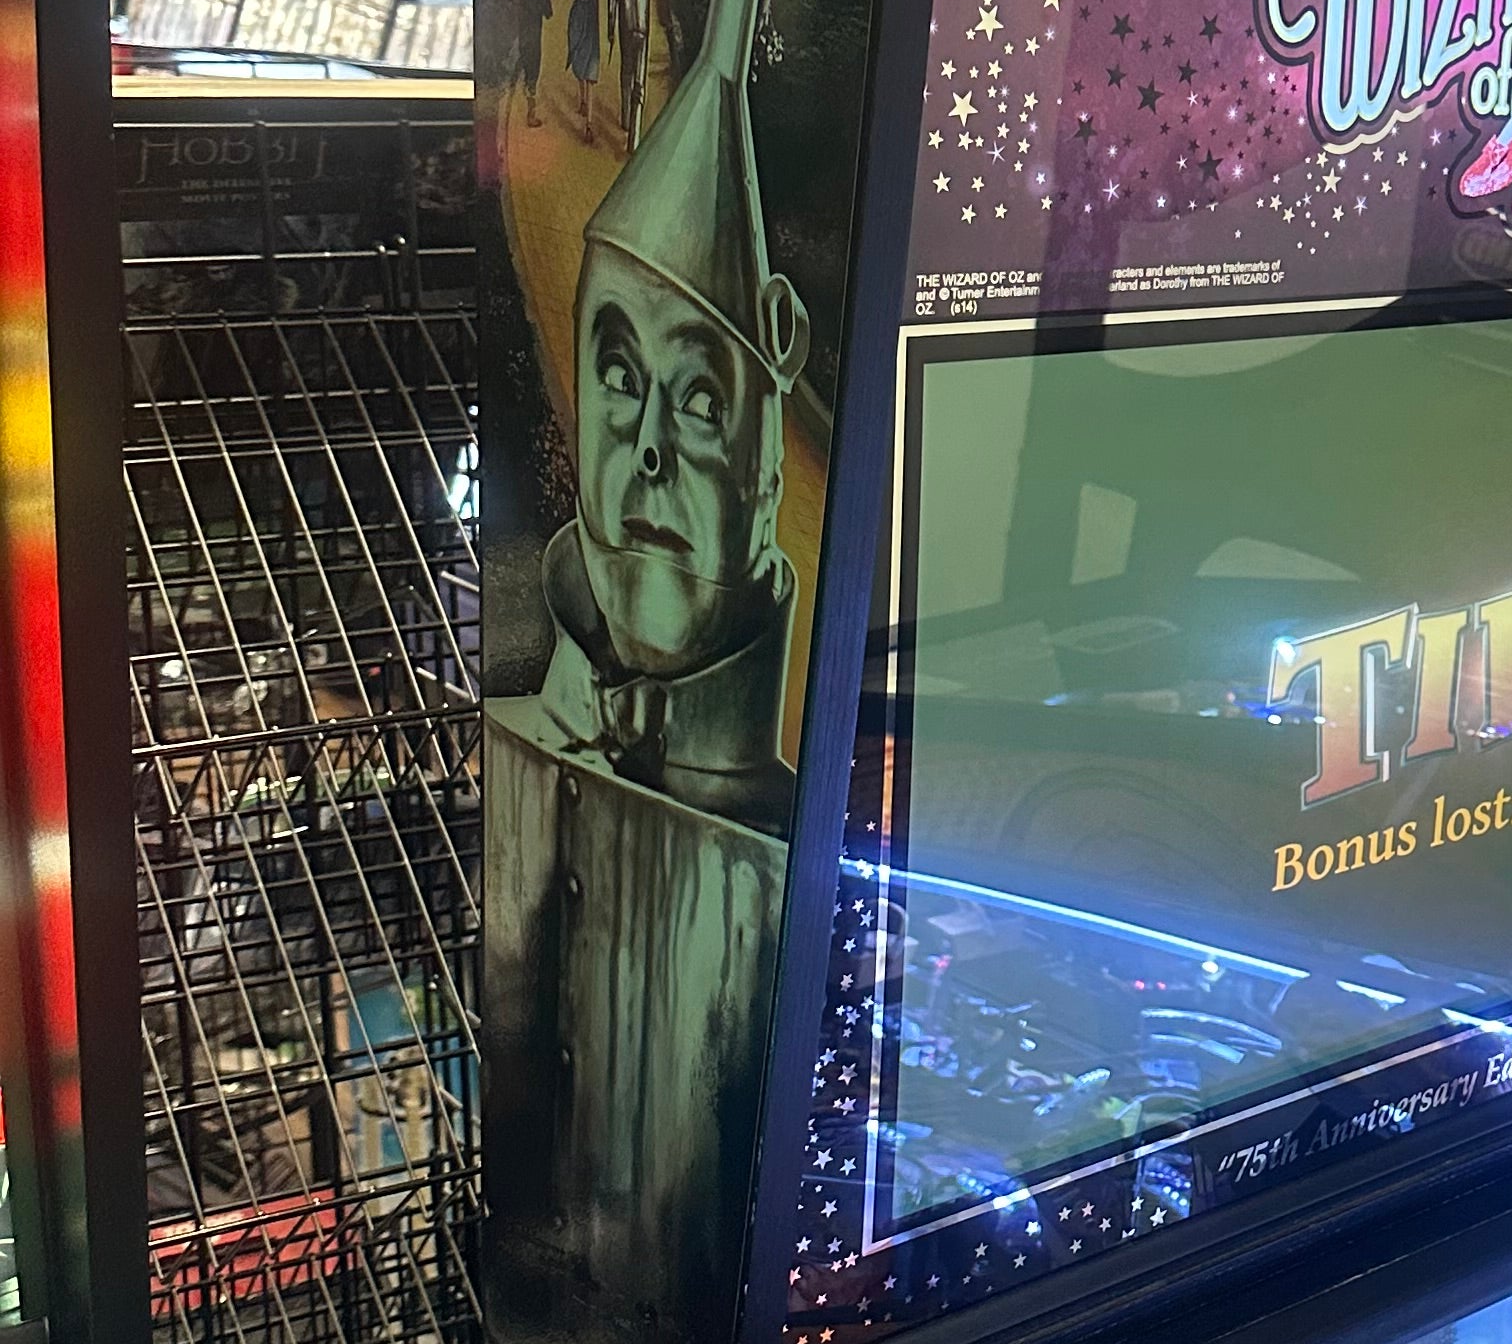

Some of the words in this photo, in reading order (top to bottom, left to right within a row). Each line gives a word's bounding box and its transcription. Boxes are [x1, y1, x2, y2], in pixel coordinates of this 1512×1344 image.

[916, 275, 941, 287] THE
[942, 272, 988, 286] WIZARD
[990, 271, 1007, 284] OF
[1008, 270, 1026, 283] OZ
[1112, 267, 1144, 279] racters
[1146, 264, 1163, 277] and
[1165, 263, 1205, 277] elements
[1206, 262, 1221, 274] are
[1223, 260, 1270, 273] trademarks
[1271, 259, 1281, 271] of
[1139, 279, 1151, 291] as
[1153, 277, 1189, 291] Dorothy
[1190, 276, 1210, 288] from
[1211, 275, 1231, 287] THE
[1232, 272, 1270, 285] WIZARD
[1271, 271, 1285, 284] OF
[915, 288, 936, 301] and
[1271, 822, 1417, 892] Bonus
[1305, 1068, 1478, 1156] Anniversary
